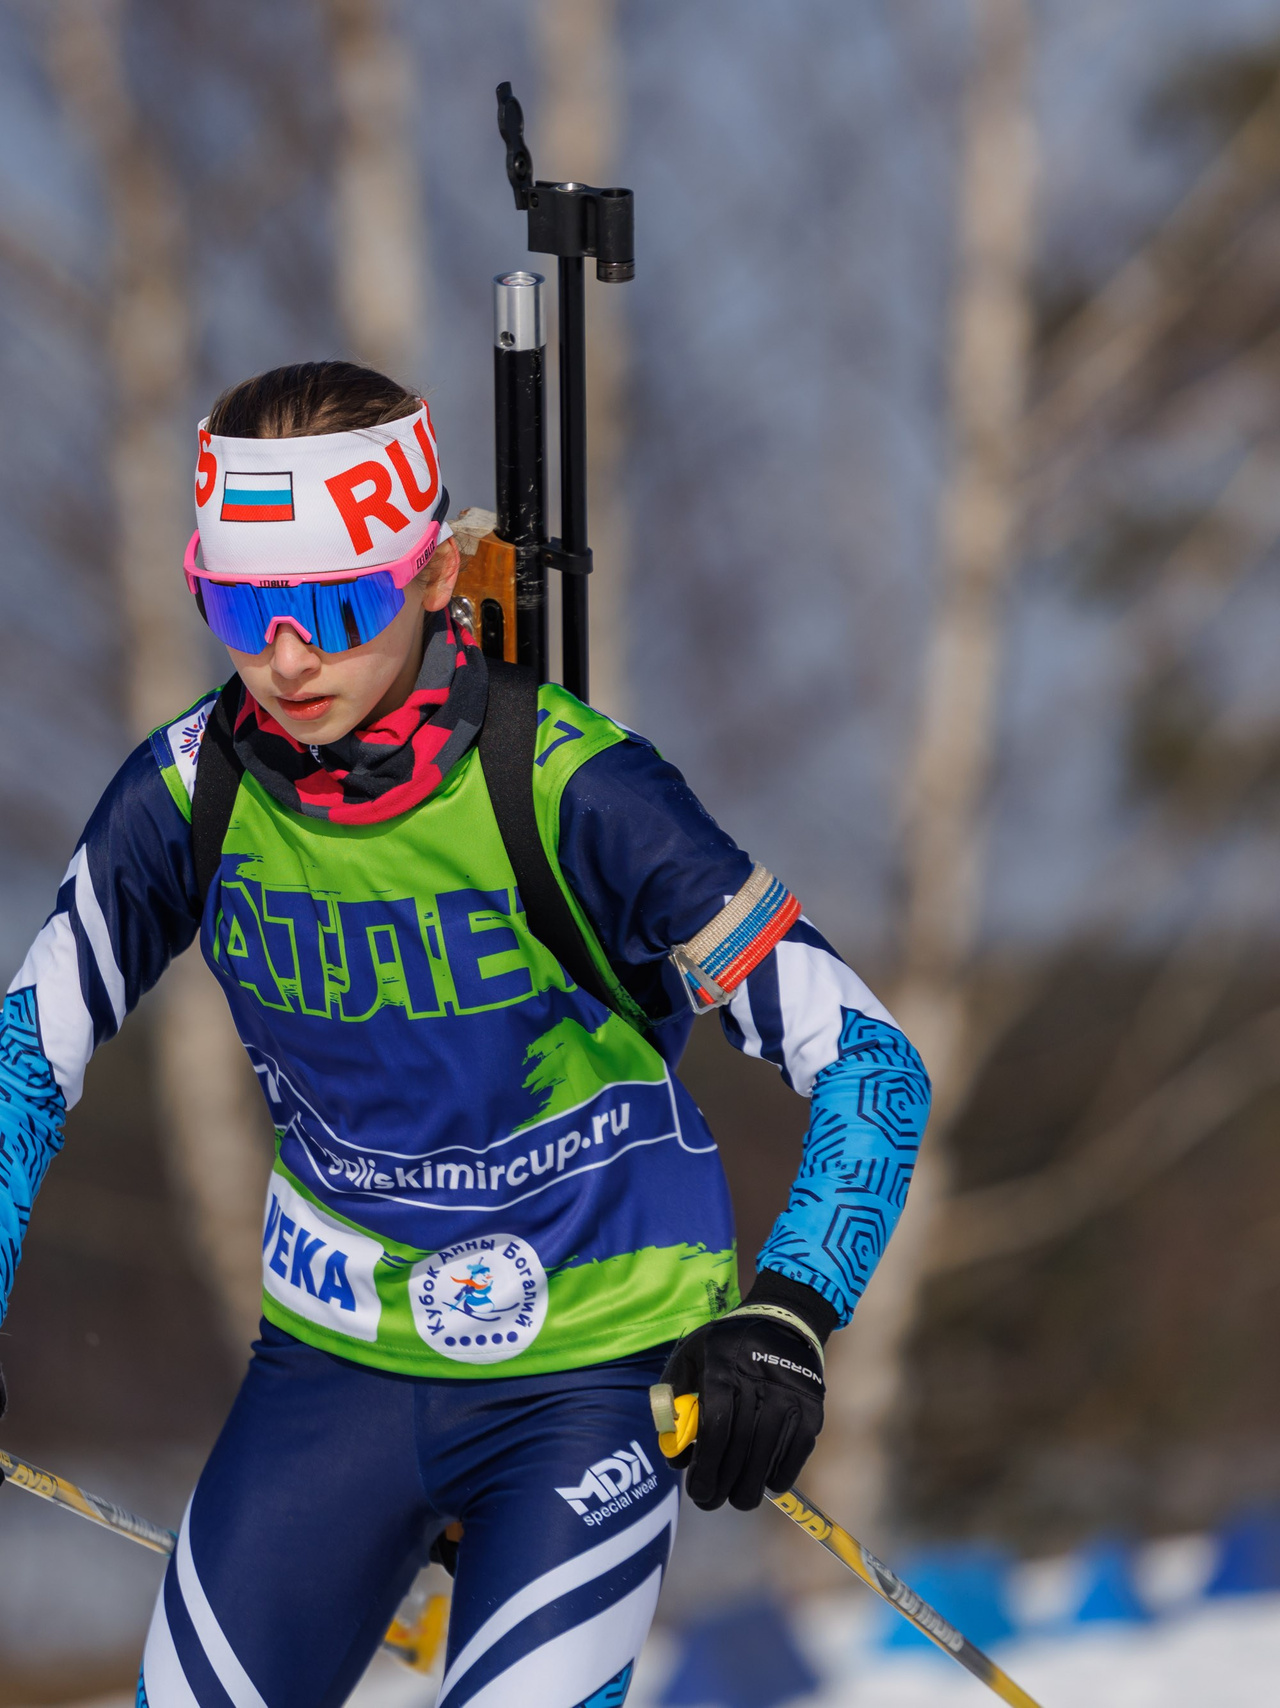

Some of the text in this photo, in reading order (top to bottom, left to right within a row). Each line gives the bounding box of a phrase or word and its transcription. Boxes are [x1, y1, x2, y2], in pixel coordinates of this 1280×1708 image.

[325, 398, 440, 556] RU
[214, 880, 560, 1022] АТЛЕ
[419, 1239, 537, 1336] Кубок Анны Богалий
[751, 1351, 822, 1385] NORDSKI
[583, 1474, 658, 1526] special wear
